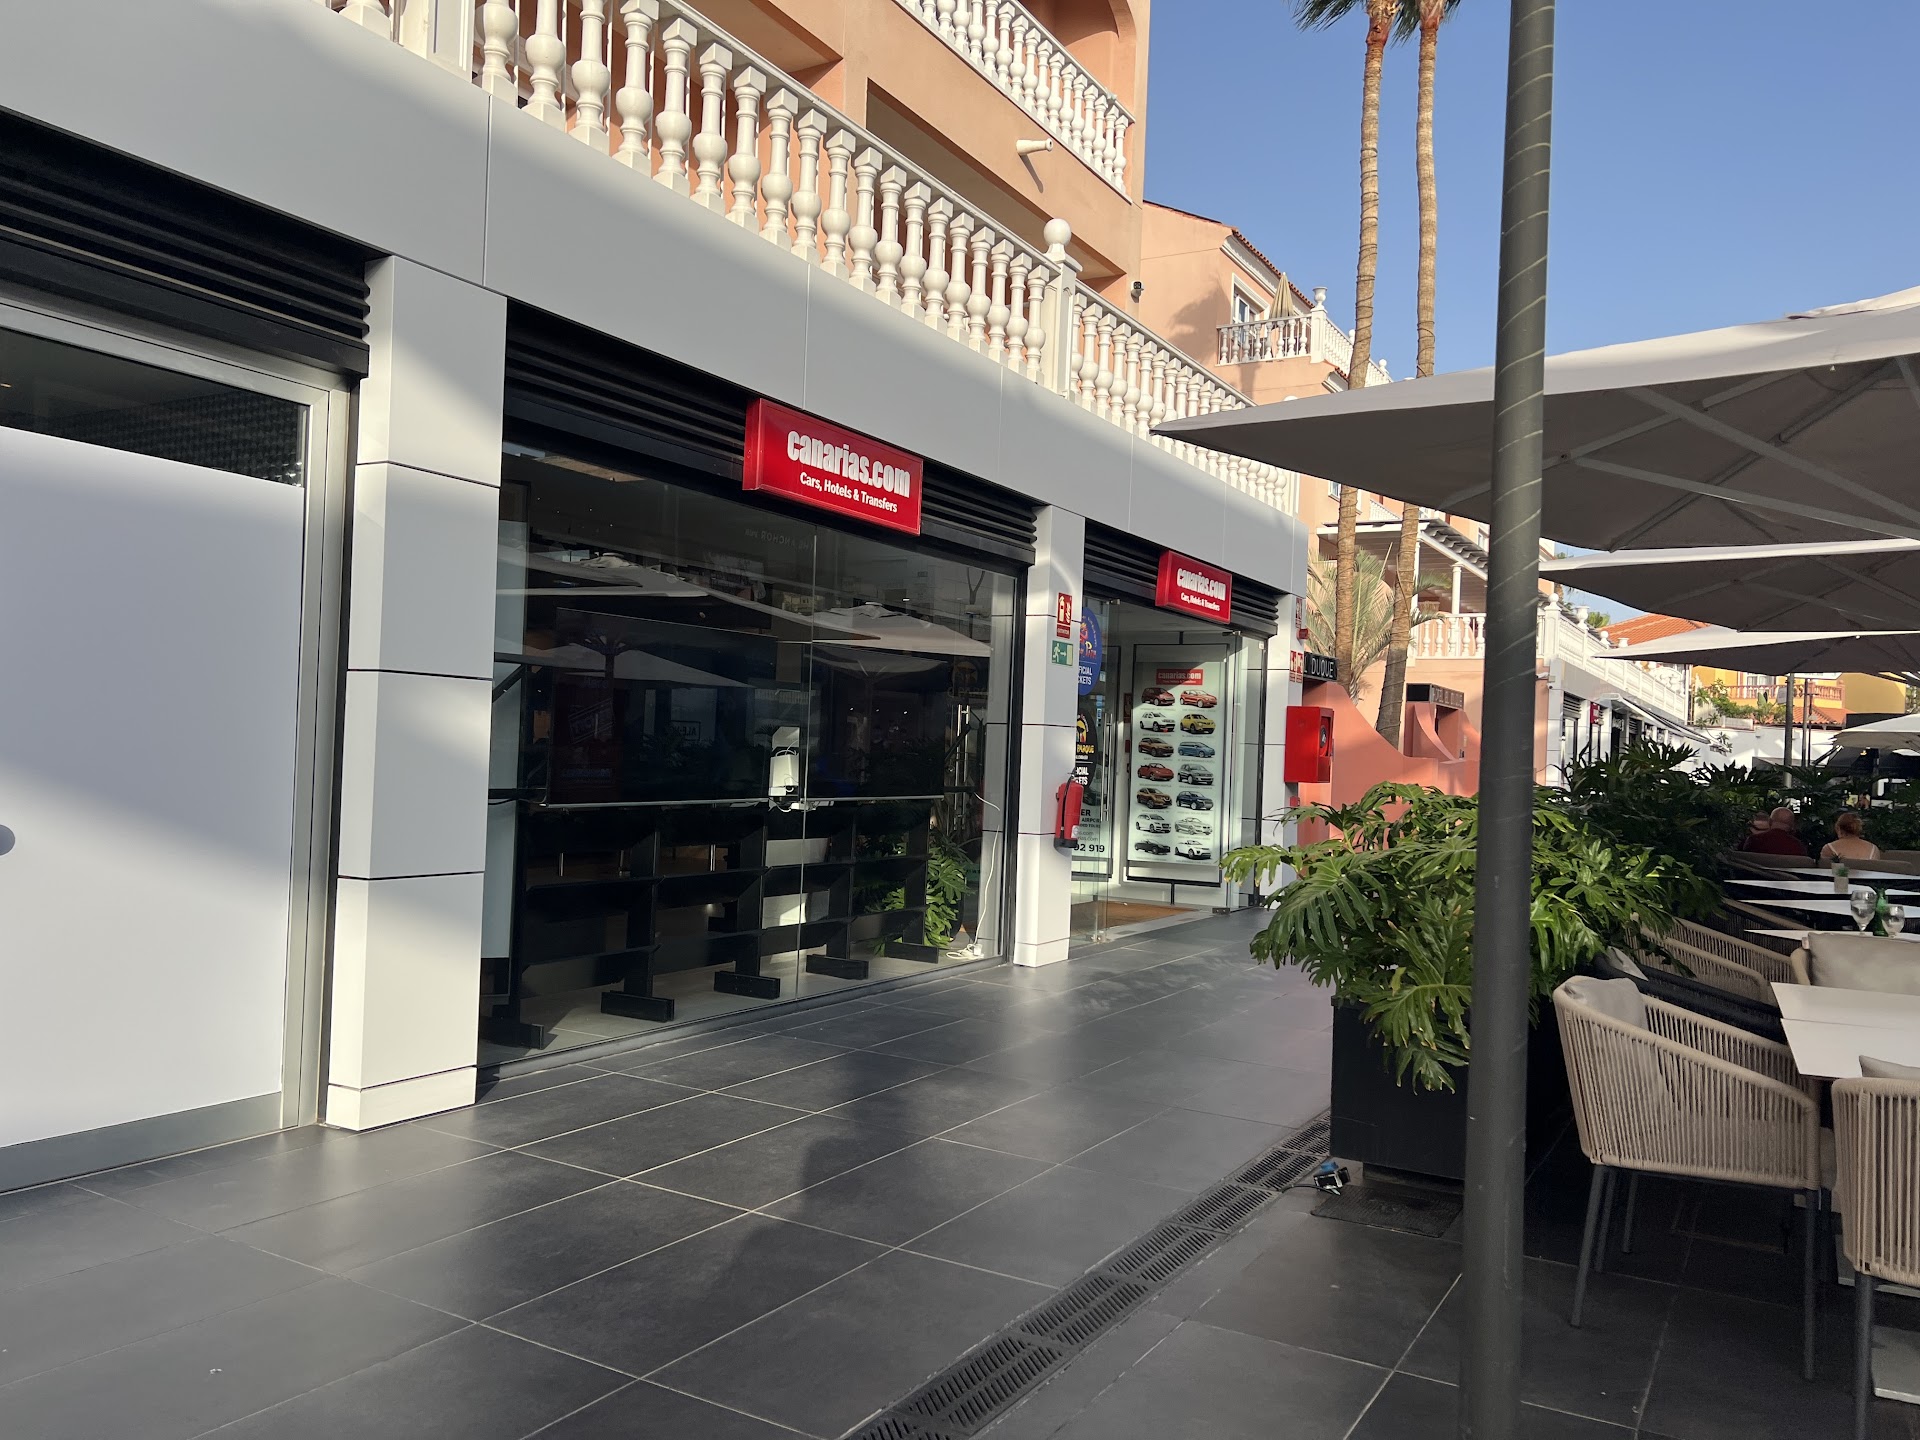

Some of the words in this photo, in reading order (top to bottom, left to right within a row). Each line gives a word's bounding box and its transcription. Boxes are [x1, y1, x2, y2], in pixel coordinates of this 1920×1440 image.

[787, 430, 911, 498] canarias.com
[800, 472, 822, 492] Cars,
[823, 479, 852, 499] Hotels
[853, 489, 860, 501] &
[860, 490, 898, 513] Transfers
[1177, 567, 1227, 602] canarias.com
[1078, 665, 1093, 676] FICIAL
[1158, 671, 1202, 680] canarias.com
[1311, 658, 1335, 678] DUQUE
[1080, 808, 1091, 817] ER
[1088, 843, 1105, 853] 919
